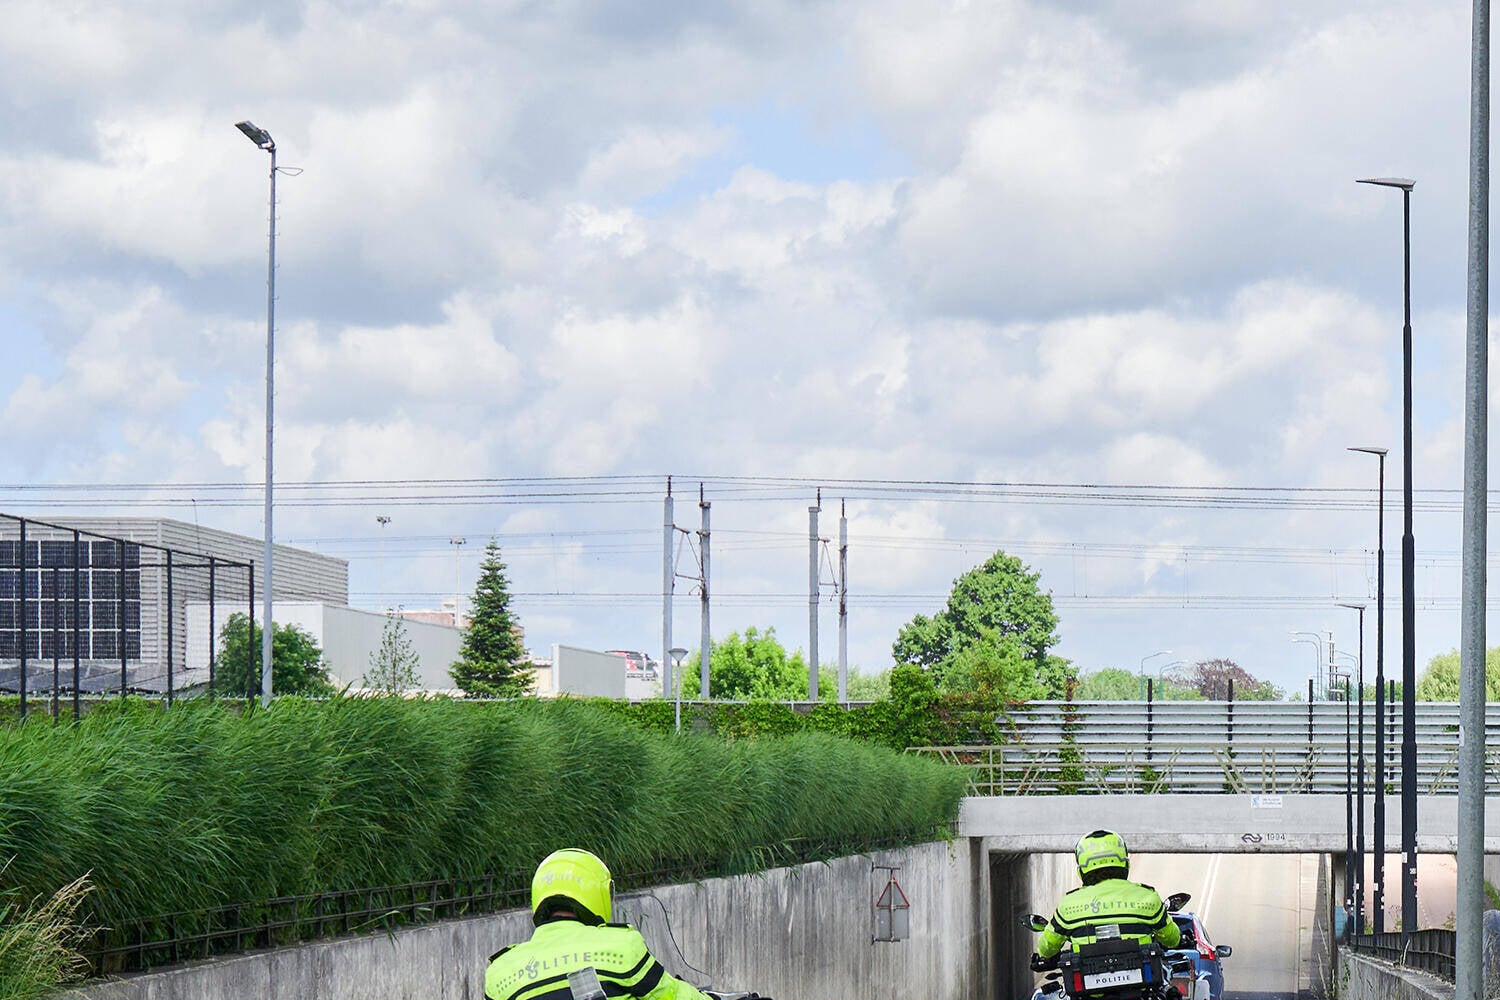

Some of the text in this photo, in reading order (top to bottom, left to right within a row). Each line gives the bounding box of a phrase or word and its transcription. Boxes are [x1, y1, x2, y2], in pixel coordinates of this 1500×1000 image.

[1267, 833, 1287, 841] 1994
[1084, 897, 1136, 914] POLITIE
[518, 952, 592, 980] POLITIE
[1095, 975, 1131, 985] POLITIE
